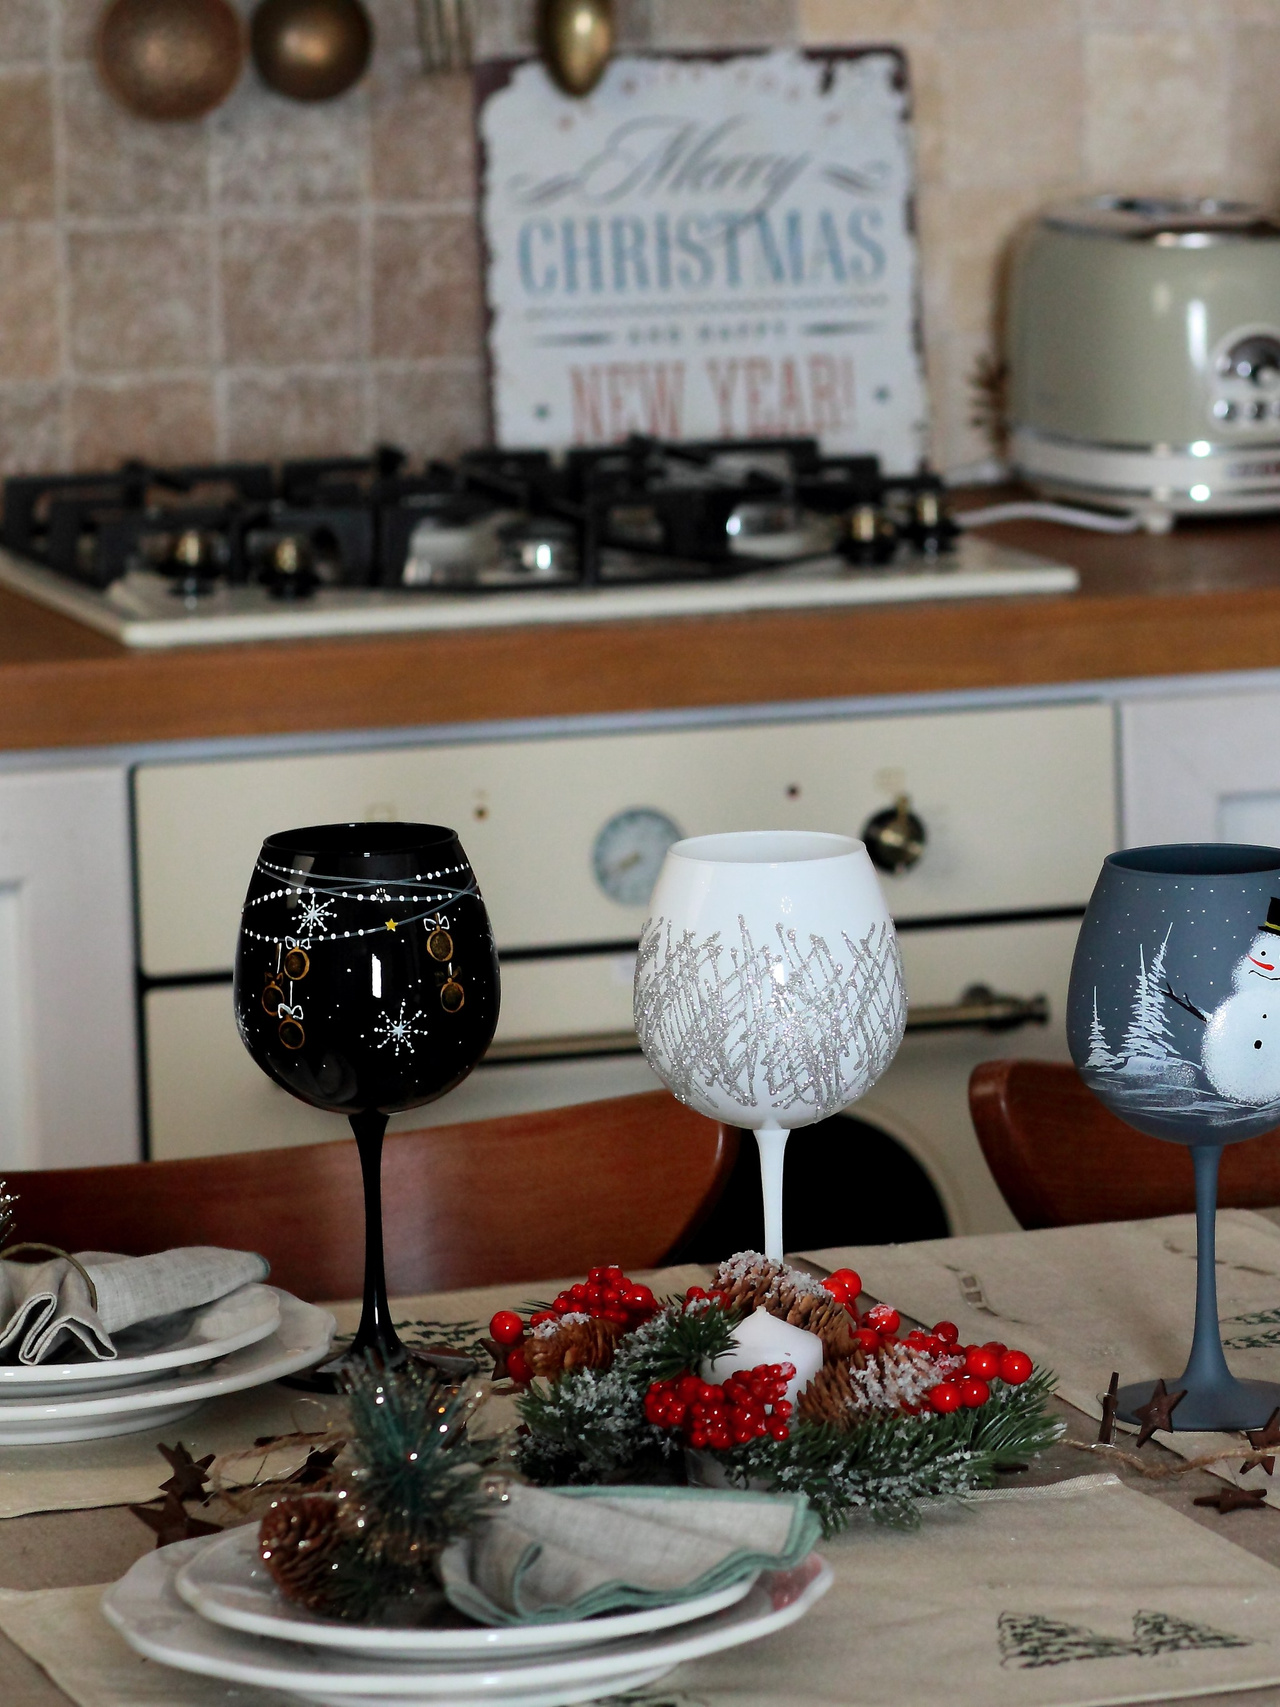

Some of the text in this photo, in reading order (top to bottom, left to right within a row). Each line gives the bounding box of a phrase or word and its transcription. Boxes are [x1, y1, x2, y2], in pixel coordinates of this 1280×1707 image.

[572, 113, 813, 243] Merry
[516, 206, 888, 297] CHRISTMAS
[568, 360, 686, 444] NEW
